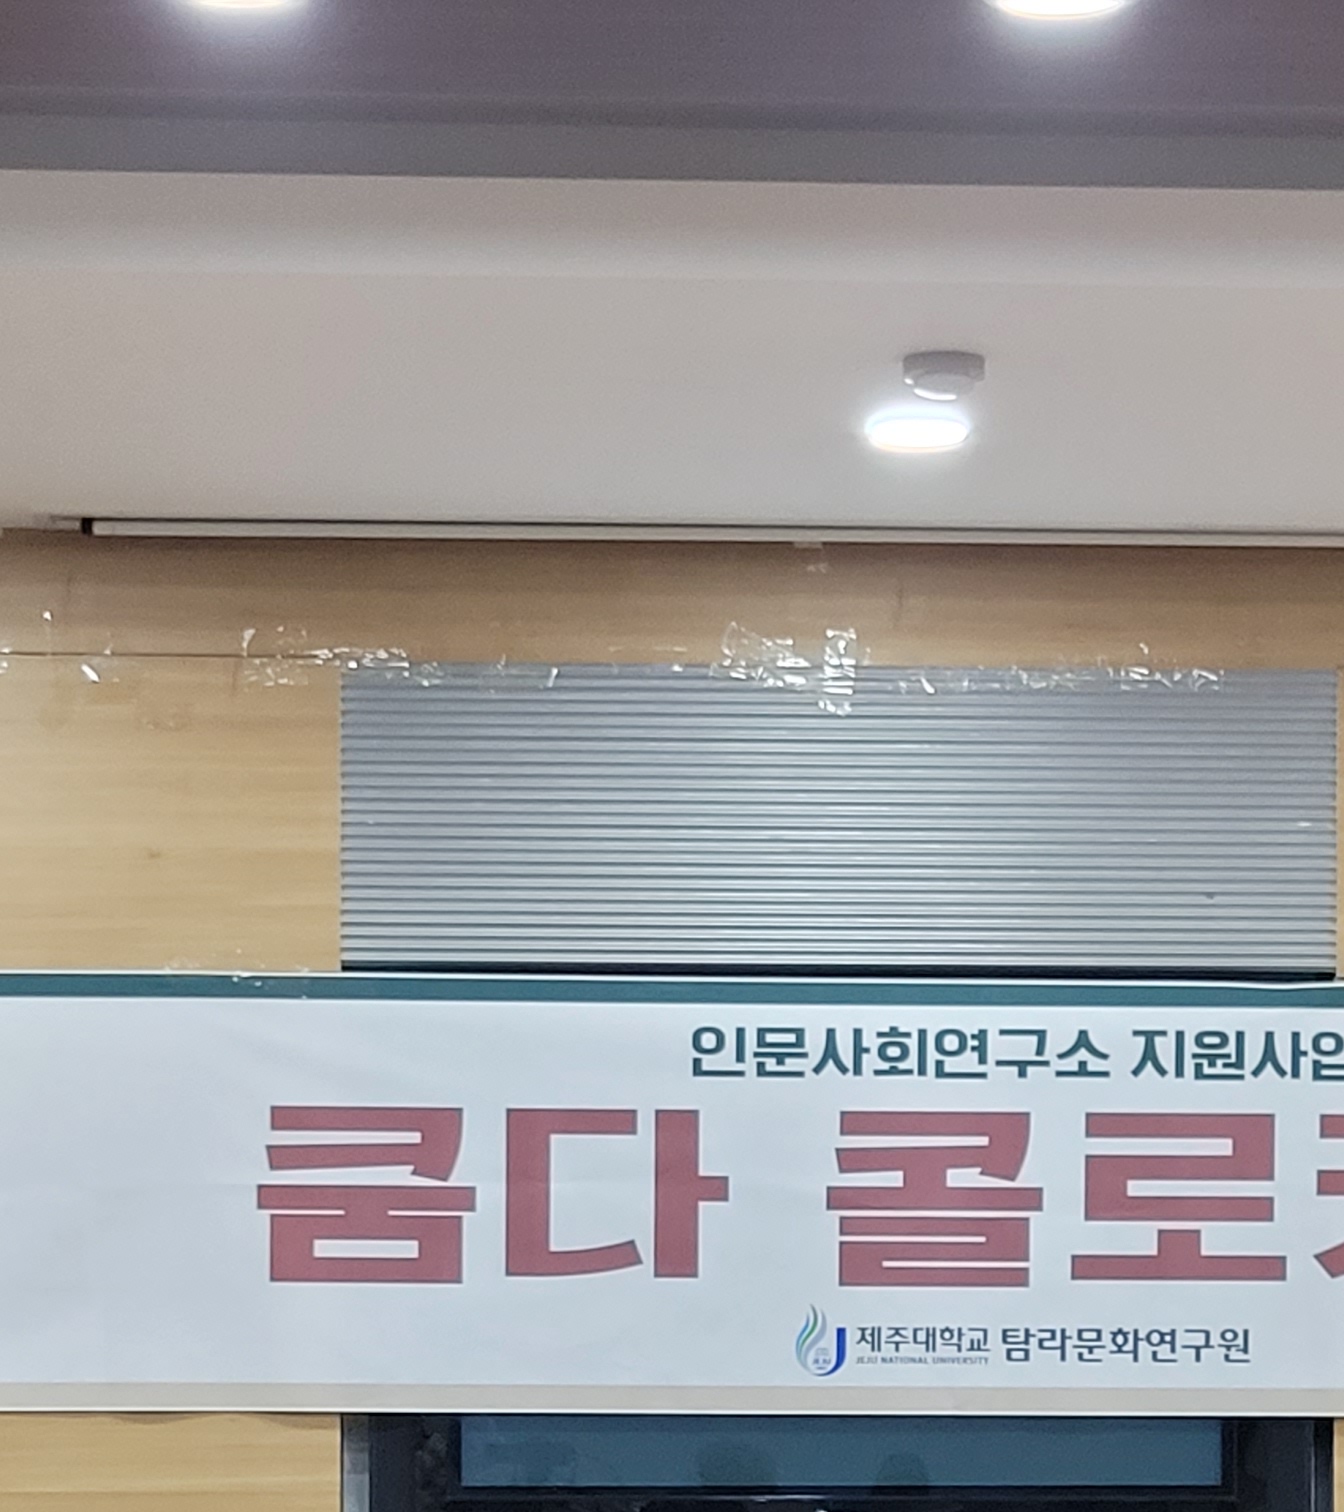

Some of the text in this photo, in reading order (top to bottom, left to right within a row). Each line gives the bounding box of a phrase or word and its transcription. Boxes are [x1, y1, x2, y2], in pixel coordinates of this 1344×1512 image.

[690, 1025, 1112, 1080] 인문사회연구소
[256, 1105, 730, 1284] 쿰다
[855, 1325, 1253, 1364] 제주대학교 탐라문화연구원
[880, 1356, 929, 1366] NATIONAL
[931, 1356, 990, 1366] UNIVERSITY
